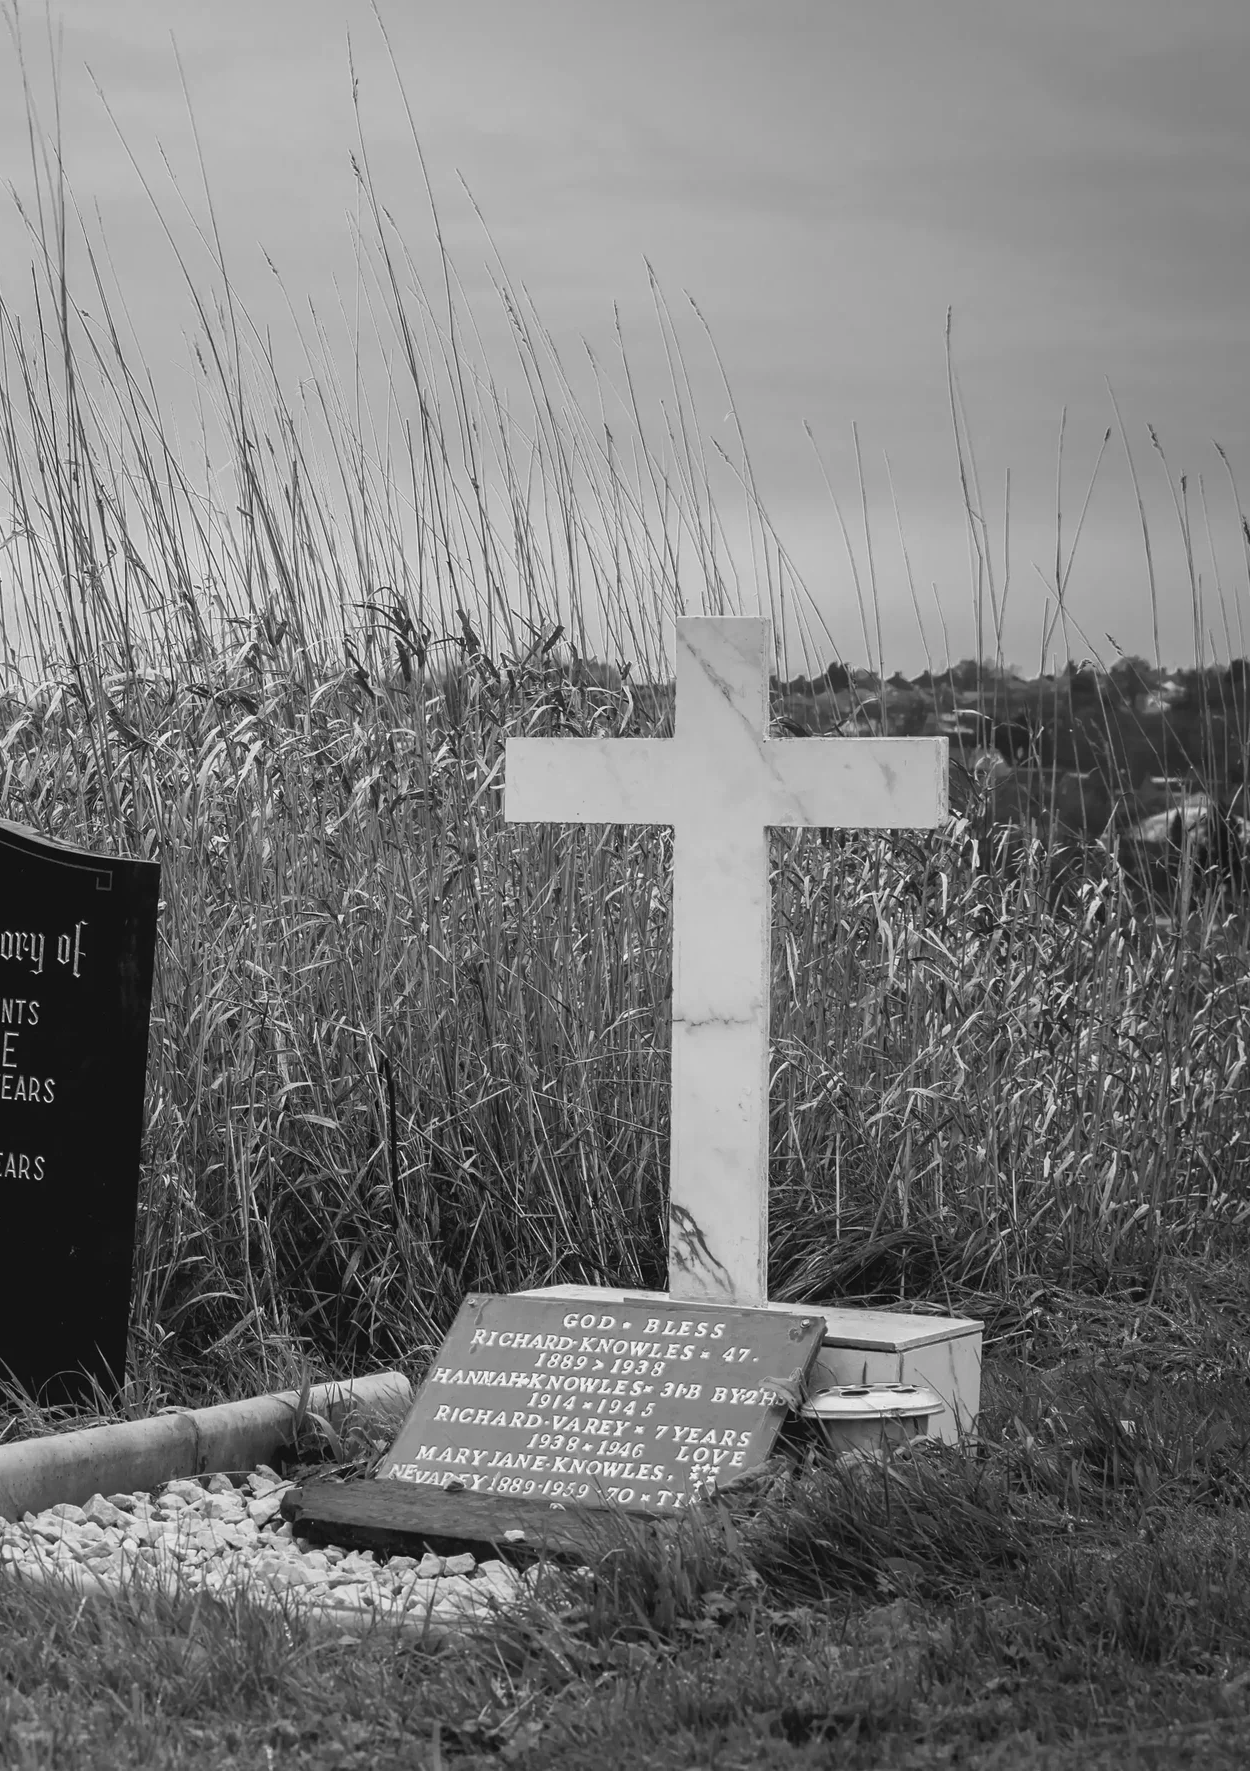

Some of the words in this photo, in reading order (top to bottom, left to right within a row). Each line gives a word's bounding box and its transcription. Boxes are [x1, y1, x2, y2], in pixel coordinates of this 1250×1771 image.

[57, 920, 88, 978] of
[562, 1313, 616, 1331] GOD
[643, 1318, 726, 1339] BLESS
[534, 1352, 588, 1371] 1889
[610, 1358, 666, 1377] 1938
[527, 1391, 577, 1411] 1914
[596, 1398, 655, 1418] 1945
[527, 1433, 580, 1452] 1938
[596, 1439, 645, 1458] 1946
[655, 1424, 669, 1440] 7
[672, 1425, 752, 1447] YEARS
[415, 1445, 489, 1467] MARY
[675, 1445, 746, 1467] LOVE
